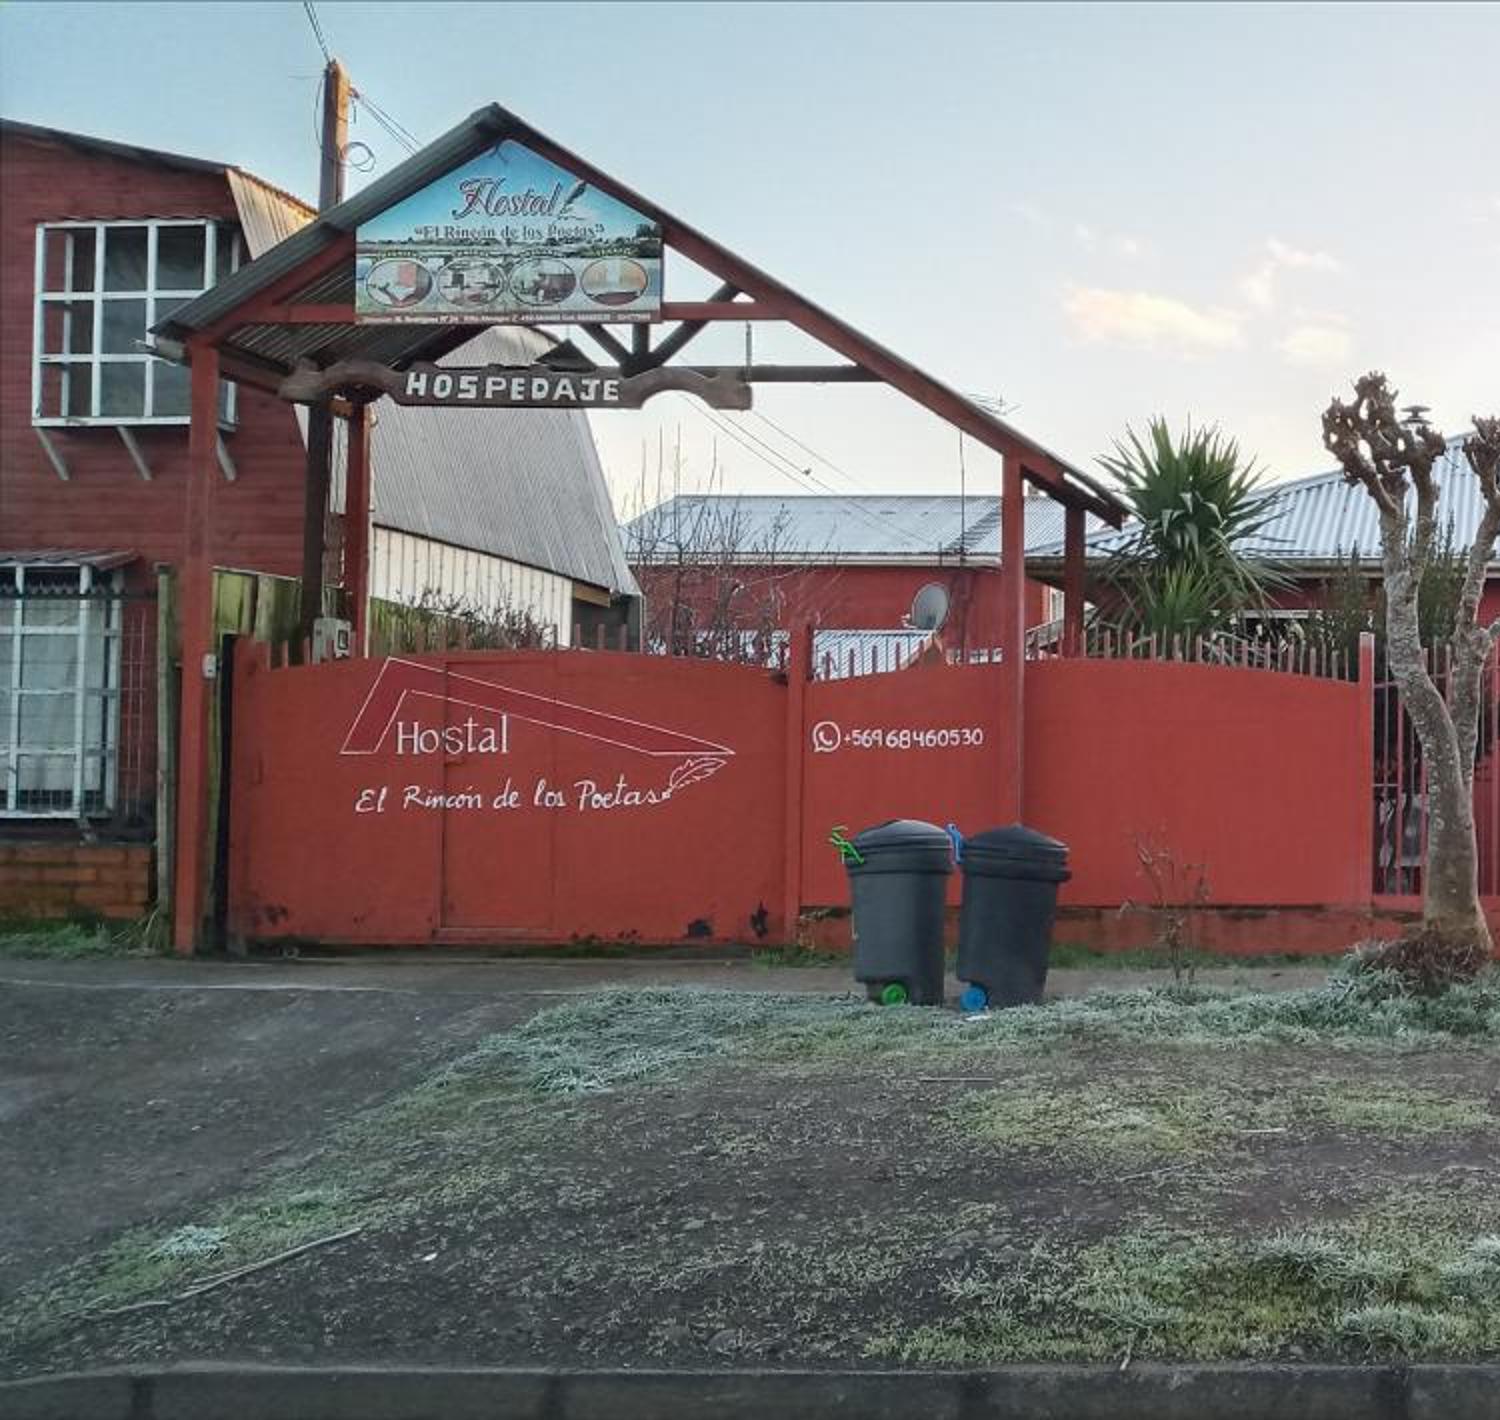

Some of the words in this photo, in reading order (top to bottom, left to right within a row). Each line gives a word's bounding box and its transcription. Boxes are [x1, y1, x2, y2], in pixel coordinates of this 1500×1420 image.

[451, 176, 563, 220] Hostal
[500, 223, 520, 240] de
[522, 224, 544, 240] los
[405, 371, 621, 401] HOSPEDAJE
[396, 714, 511, 756] Hostal
[355, 786, 387, 814] El
[403, 784, 482, 811] Rincón
[492, 778, 522, 810] de
[533, 778, 567, 809] los
[573, 772, 662, 815] Poetas
